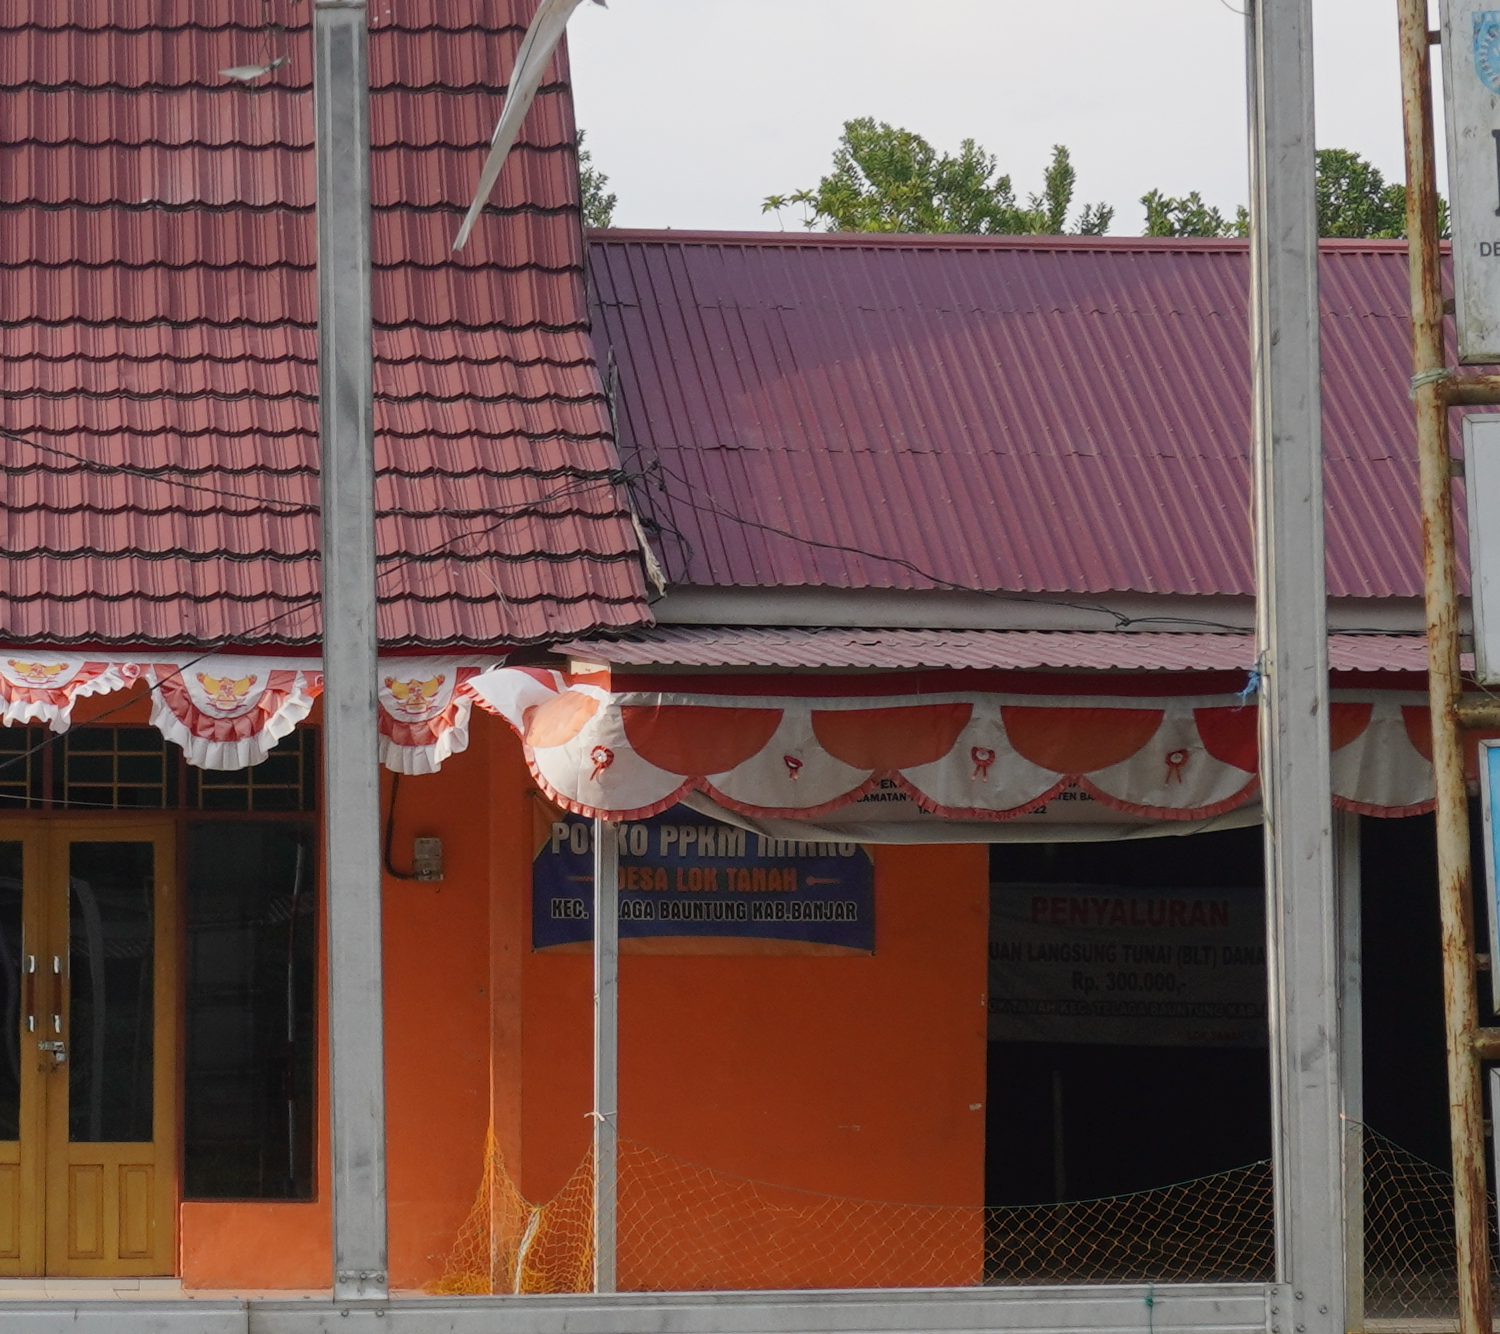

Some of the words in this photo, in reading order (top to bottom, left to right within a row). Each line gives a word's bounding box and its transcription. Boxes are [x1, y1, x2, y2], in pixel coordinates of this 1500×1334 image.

[551, 821, 649, 857] POKO
[660, 824, 746, 857] PPKM
[676, 867, 718, 892] LOK
[726, 867, 798, 893] TANAH
[551, 897, 590, 919] KEC.
[659, 899, 748, 922] BAUNTUNG
[1031, 896, 1229, 928] PENYALURAN
[1027, 943, 1117, 964] LANGSUNG
[1122, 944, 1172, 965] TUNAI
[1177, 945, 1217, 968] (BLT)
[1072, 971, 1100, 995] Rp.
